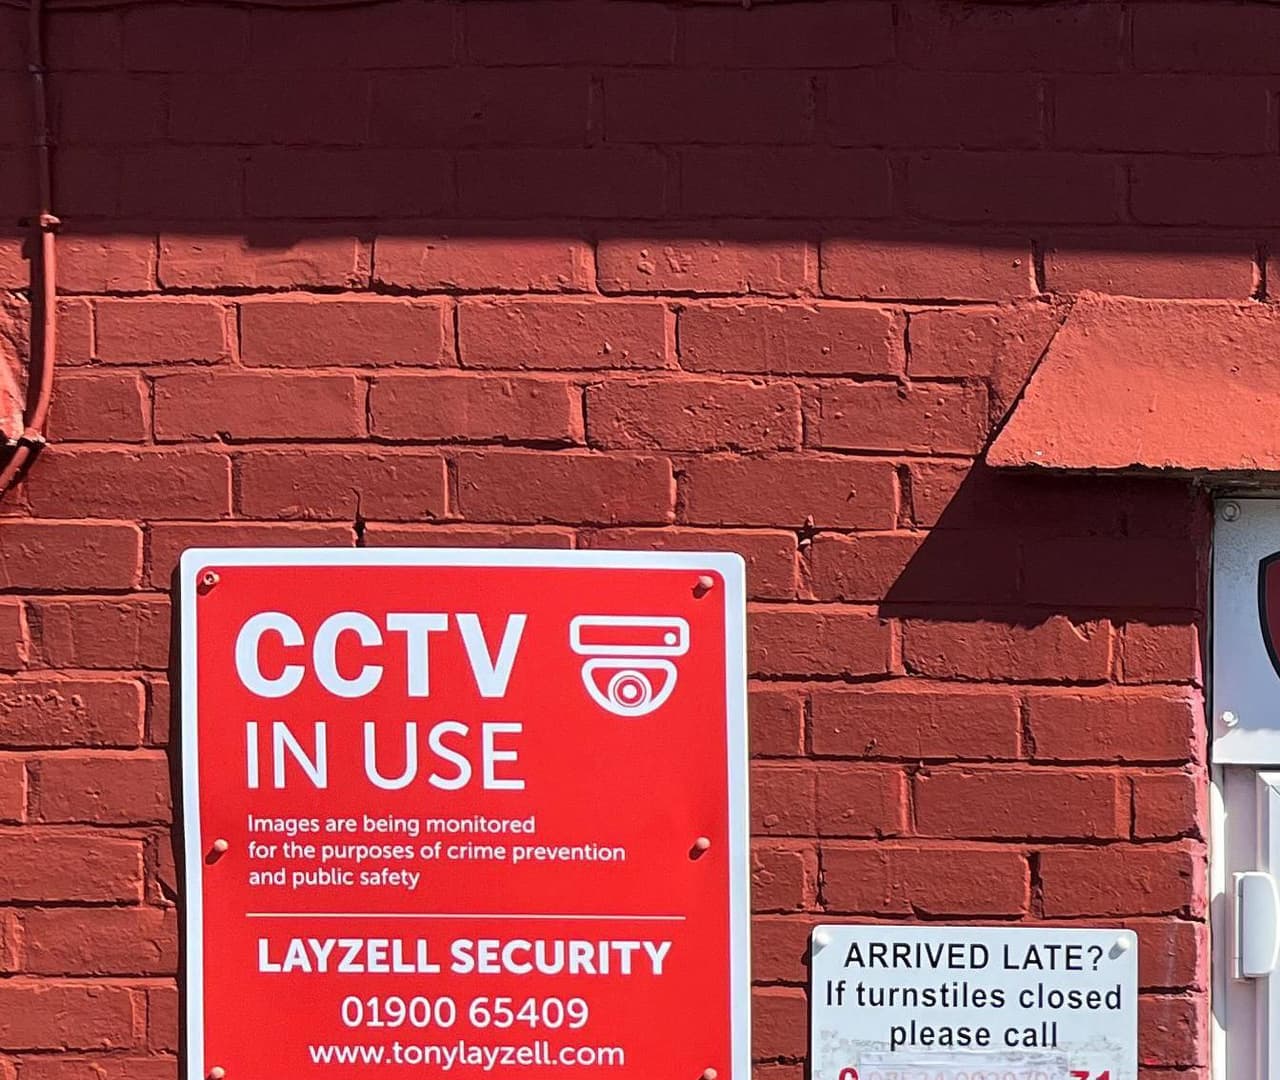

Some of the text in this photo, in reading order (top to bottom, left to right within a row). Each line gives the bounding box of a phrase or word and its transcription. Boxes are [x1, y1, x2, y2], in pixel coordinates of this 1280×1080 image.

[235, 612, 527, 699] CCTV
[246, 721, 526, 791] IN USE
[247, 815, 535, 836] Images are being monitored
[248, 841, 625, 863] for the purposes of crime prevention
[249, 867, 420, 889] and public safety
[257, 938, 672, 976] LAYZELL SECURITY
[844, 942, 1103, 971] ARRIVED LATE?
[826, 980, 1121, 1010] If turnstiles closed
[340, 995, 589, 1029] 01900 65409
[890, 1020, 1058, 1051] please call
[308, 1042, 625, 1070] www.tonylayzell.com
